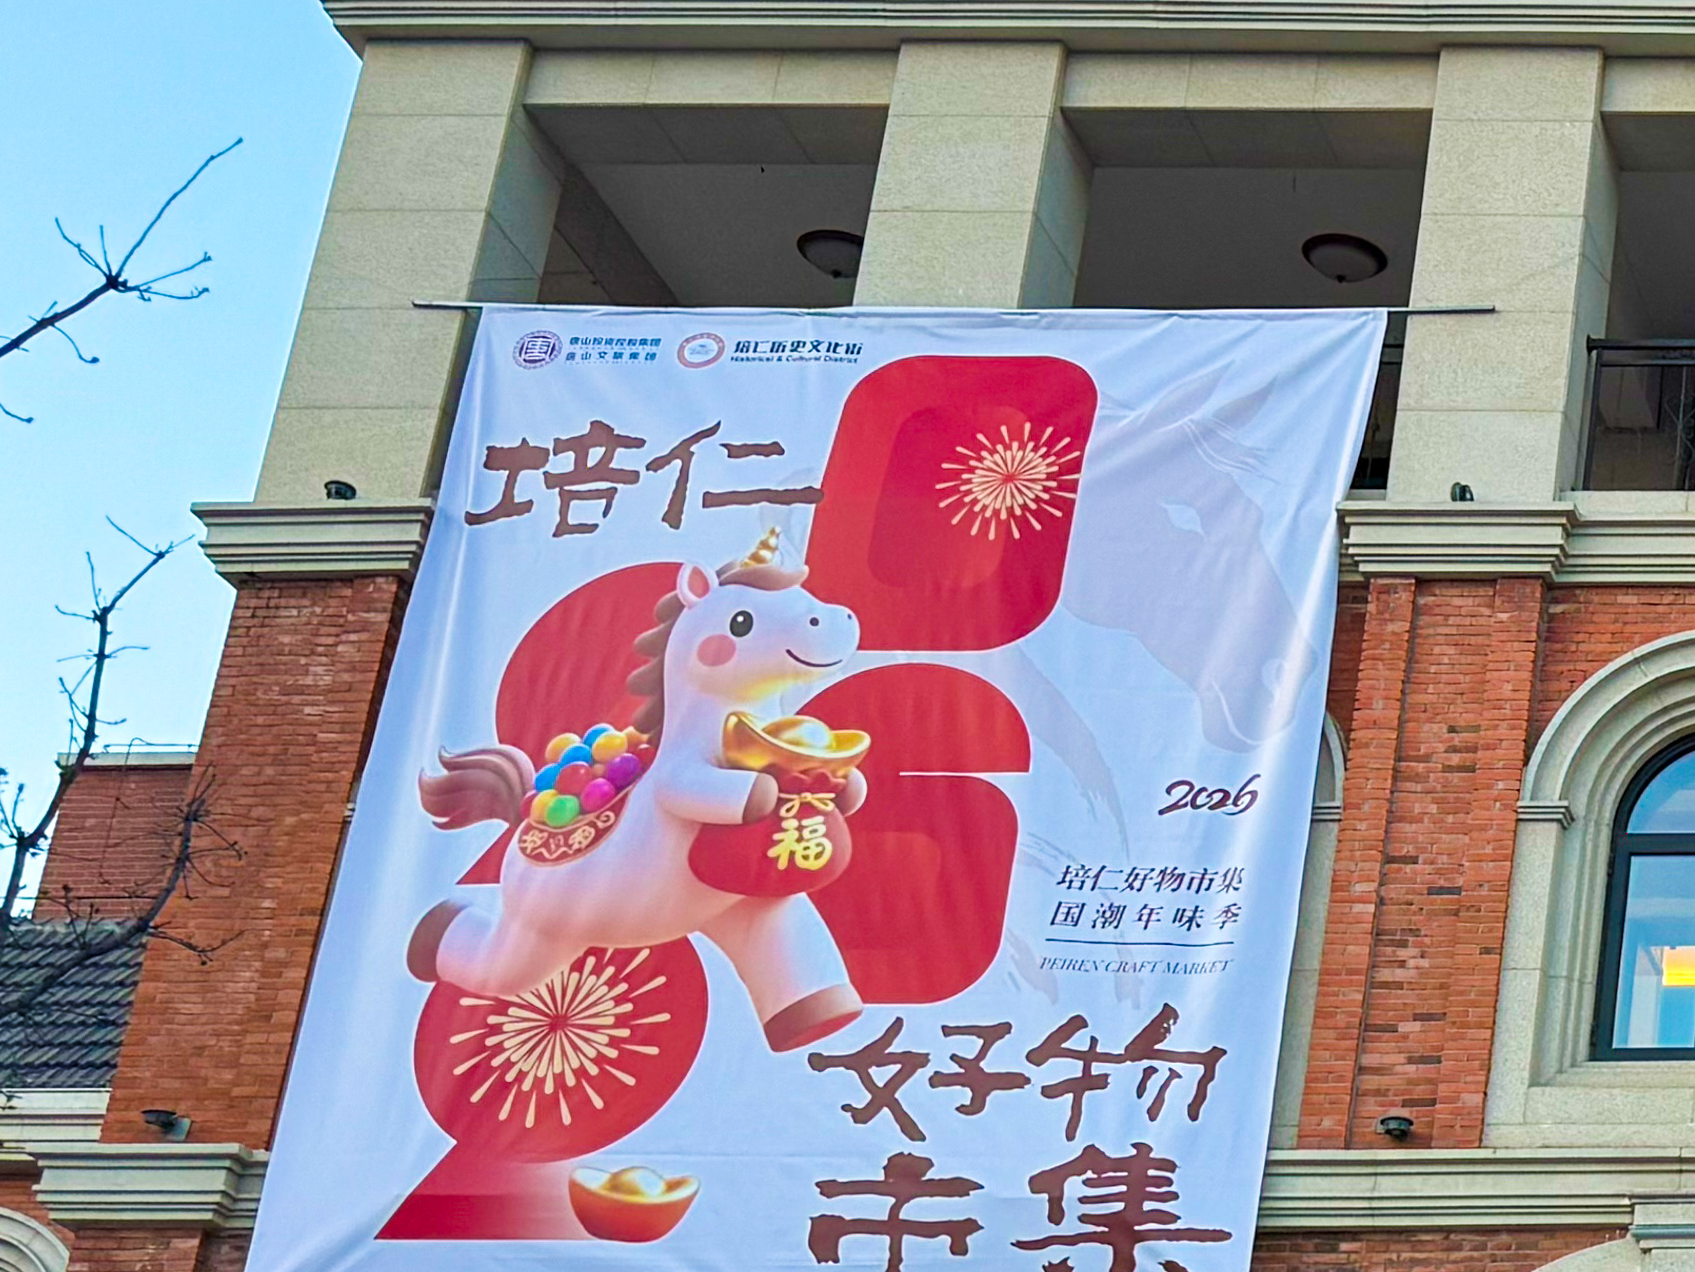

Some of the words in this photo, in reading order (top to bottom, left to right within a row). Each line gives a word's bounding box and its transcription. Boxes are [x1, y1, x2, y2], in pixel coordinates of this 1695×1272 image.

[464, 420, 824, 537] 培仁
[1157, 773, 1261, 816] 2026
[766, 816, 833, 871] 福
[1056, 864, 1245, 894] 培仁好物市集
[1049, 901, 1243, 932] 国潮年味季
[1039, 956, 1103, 973] PEIREN
[1104, 957, 1160, 974] CRAFT
[1162, 957, 1234, 975] MARKET
[807, 1003, 1227, 1141] 好物
